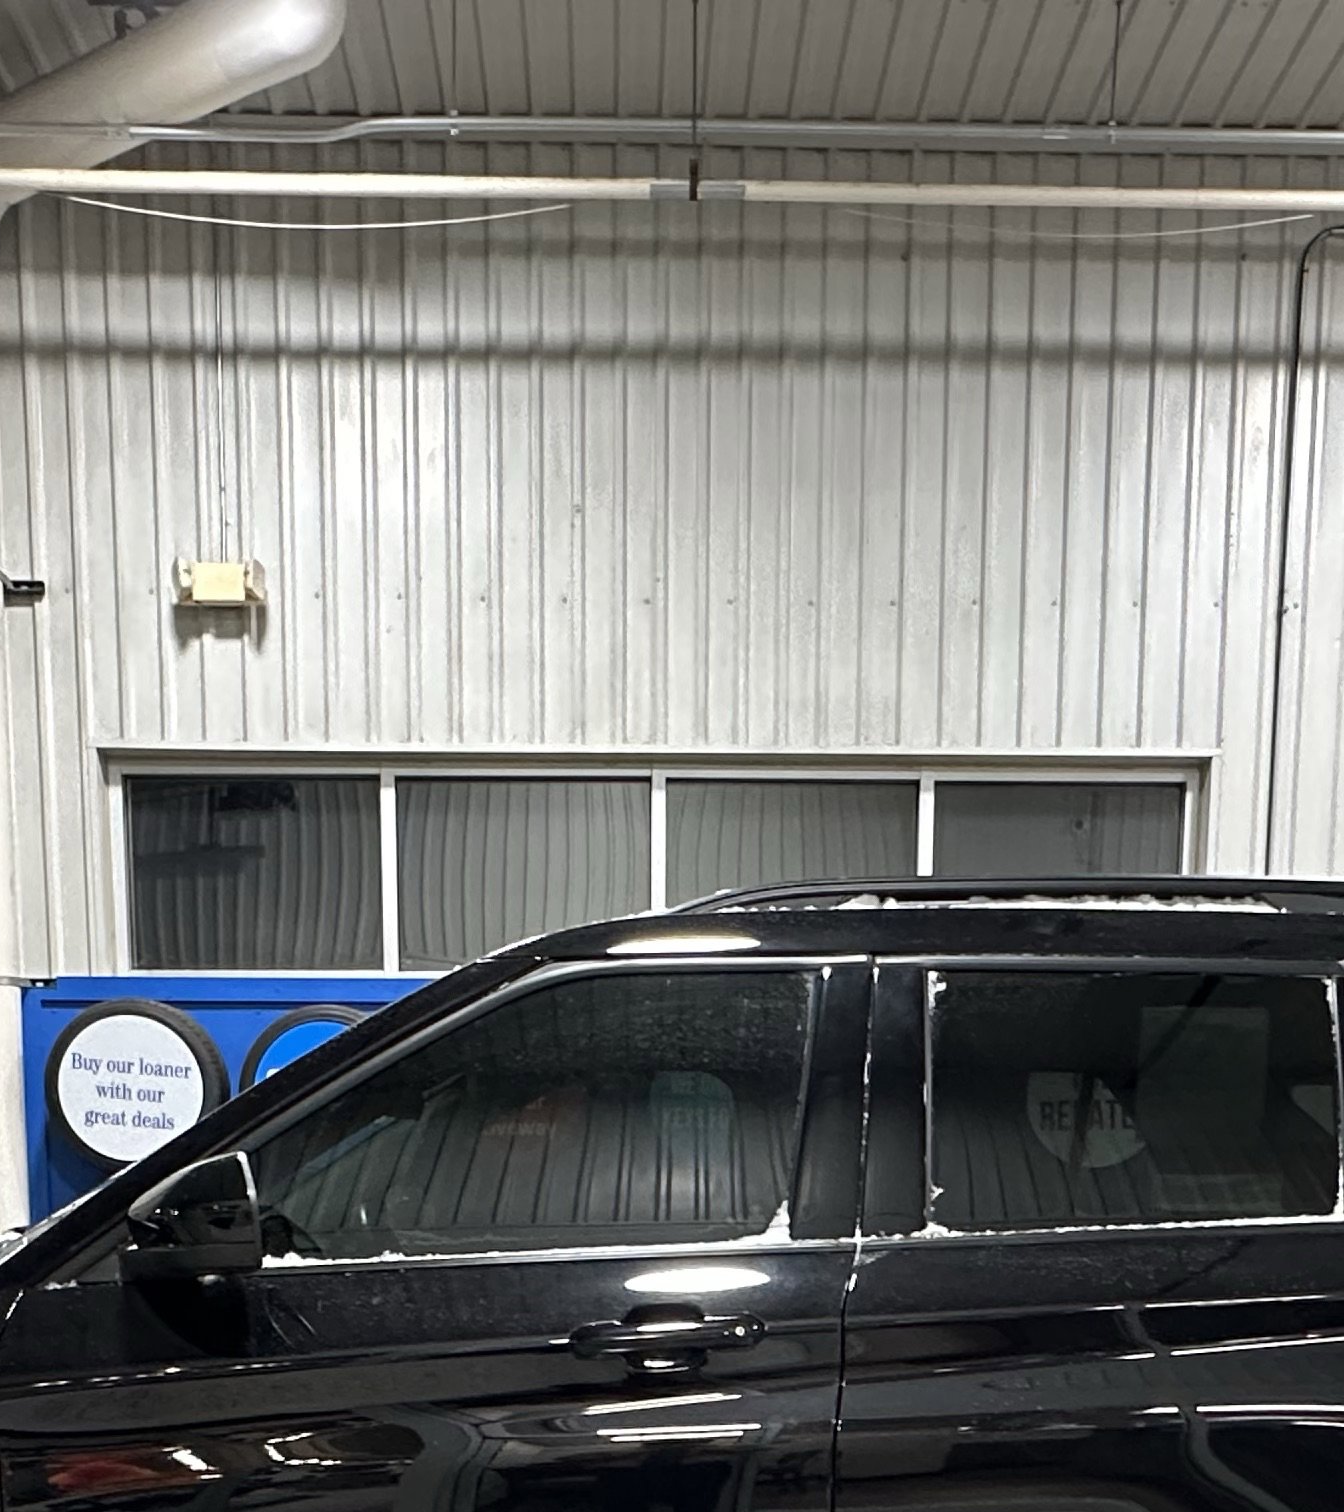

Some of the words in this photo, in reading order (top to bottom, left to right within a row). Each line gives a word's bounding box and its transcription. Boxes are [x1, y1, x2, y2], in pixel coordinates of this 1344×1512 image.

[71, 1052, 103, 1075] Buy
[106, 1059, 135, 1074] our
[139, 1057, 192, 1079] loaner
[96, 1081, 132, 1101] with
[137, 1087, 165, 1103] our
[84, 1110, 127, 1128] great
[131, 1110, 175, 1130] deals
